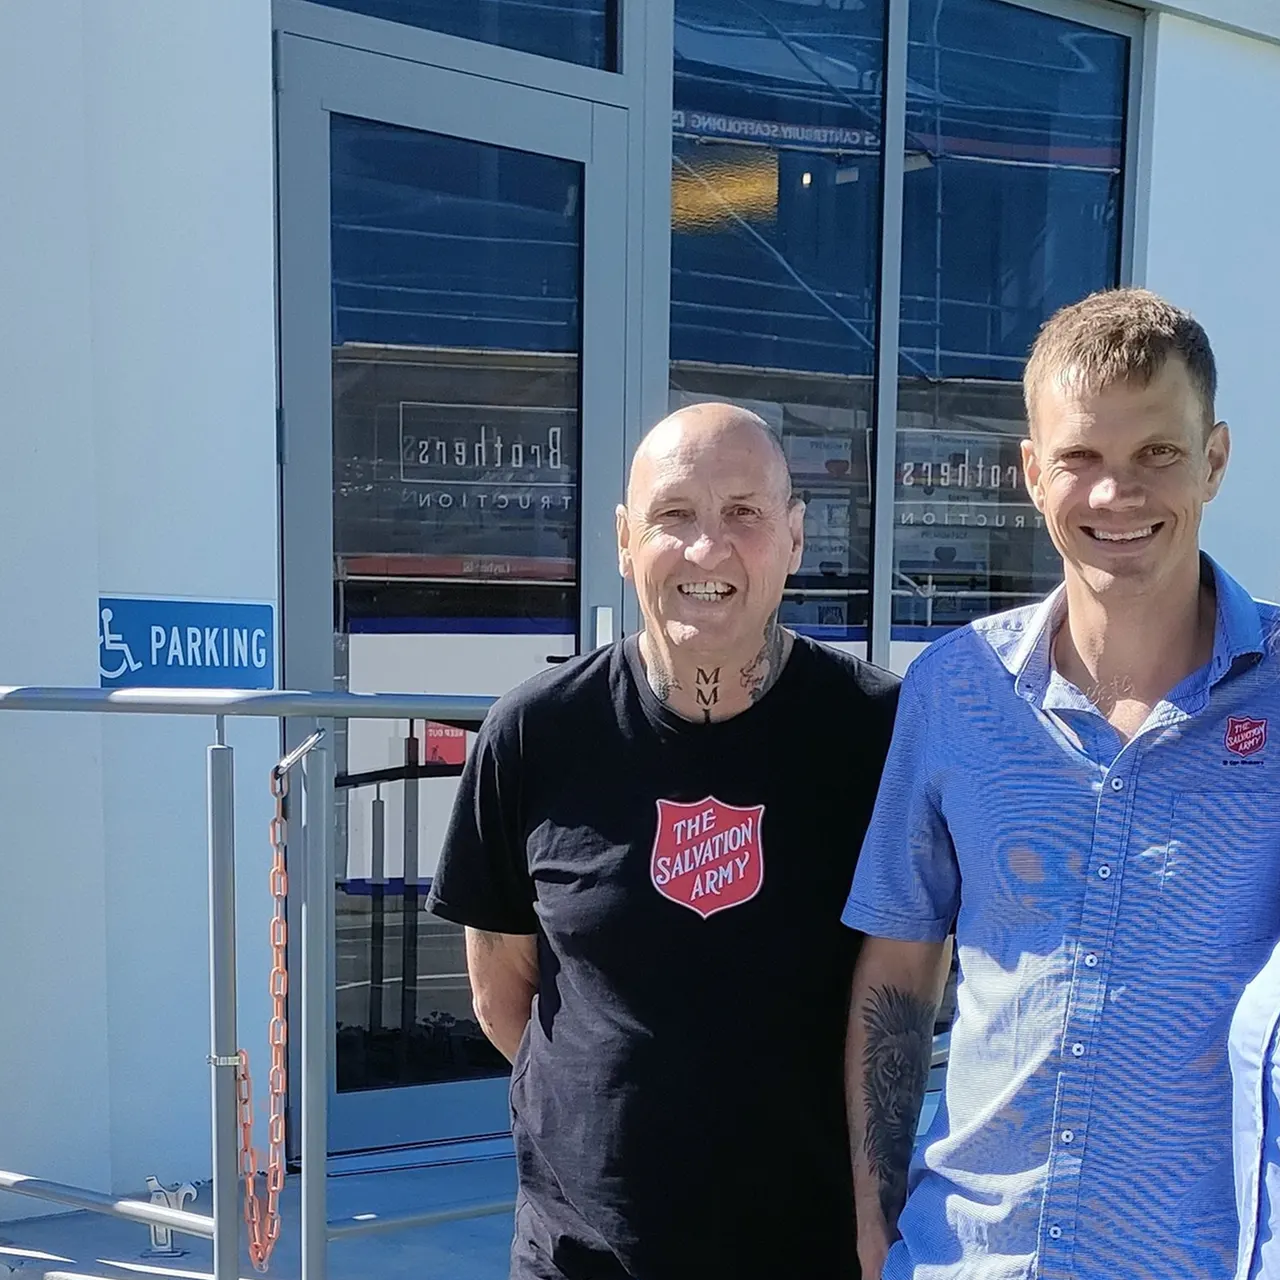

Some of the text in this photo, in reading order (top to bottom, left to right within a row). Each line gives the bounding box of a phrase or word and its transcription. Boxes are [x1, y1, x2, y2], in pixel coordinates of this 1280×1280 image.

[151, 626, 266, 669] PARKING
[673, 808, 717, 846] THE
[656, 817, 753, 885] SALVATION
[690, 851, 751, 901] ARMY
